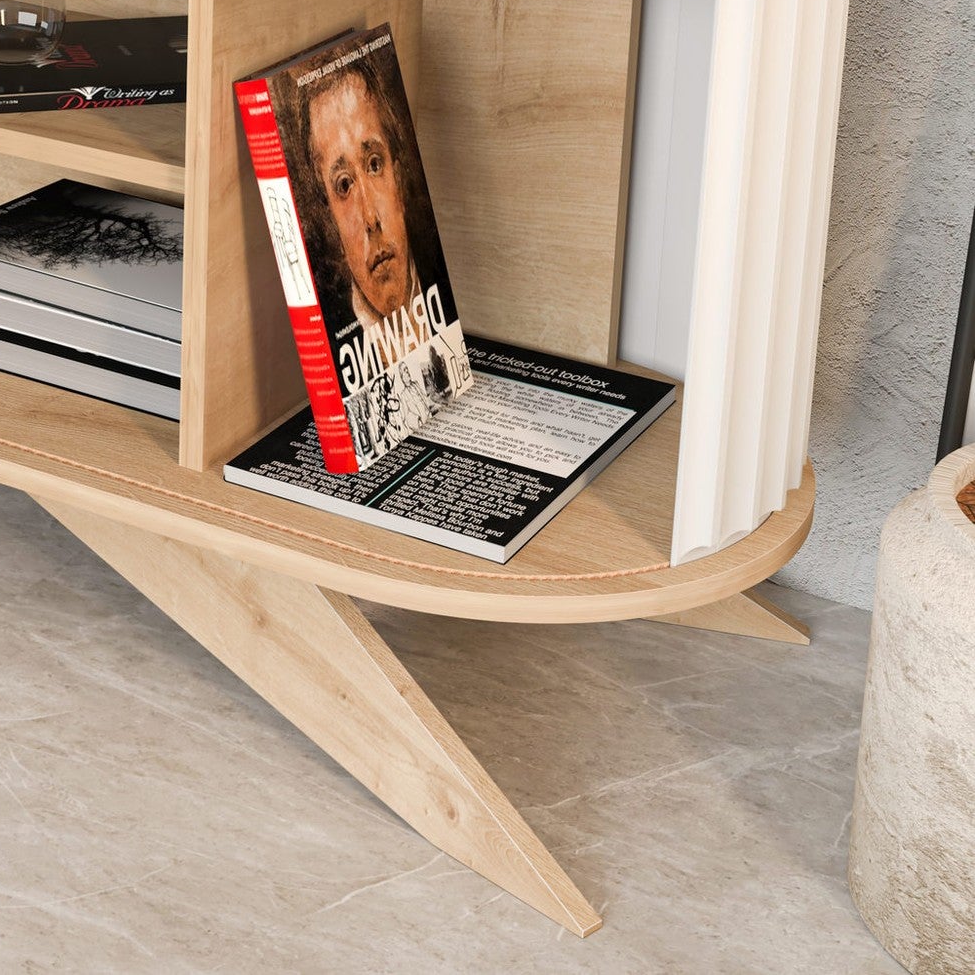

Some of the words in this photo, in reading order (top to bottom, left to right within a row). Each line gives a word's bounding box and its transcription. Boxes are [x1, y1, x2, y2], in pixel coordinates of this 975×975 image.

[57, 94, 147, 110] Drama
[104, 87, 157, 100] Writing
[487, 353, 559, 376] tricked-out
[558, 371, 609, 388] toolbox
[551, 379, 574, 388] every
[599, 391, 626, 400] needs
[270, 461, 311, 476] marketing
[353, 484, 374, 493] then
[433, 457, 477, 471] promotion
[493, 472, 510, 482] key
[510, 477, 555, 492] ingredient
[452, 455, 484, 467] today's
[483, 464, 510, 474] tough
[279, 470, 301, 479] pass
[317, 480, 340, 489] book
[439, 471, 472, 483] authors
[487, 483, 520, 496] familiar
[444, 477, 466, 487] tools
[466, 484, 505, 498] available
[394, 489, 414, 498] that
[412, 495, 439, 505] might
[437, 502, 466, 512] create
[465, 510, 490, 519] more
[417, 490, 457, 503] overlook
[455, 501, 512, 519] opportunities
[433, 488, 461, 499] things
[478, 500, 503, 510] don't
[502, 507, 526, 516] work
[437, 482, 460, 493] They
[459, 489, 488, 499] spend
[495, 498, 527, 511] fortune
[377, 503, 405, 515] Tonya
[405, 511, 440, 525] Kappes
[439, 521, 463, 532] have
[462, 528, 489, 539] taken
[382, 499, 414, 511] thrilled
[412, 507, 446, 521] Melissa
[446, 517, 485, 532] Bourbon
[421, 503, 449, 514] That's
[448, 512, 468, 521] why
